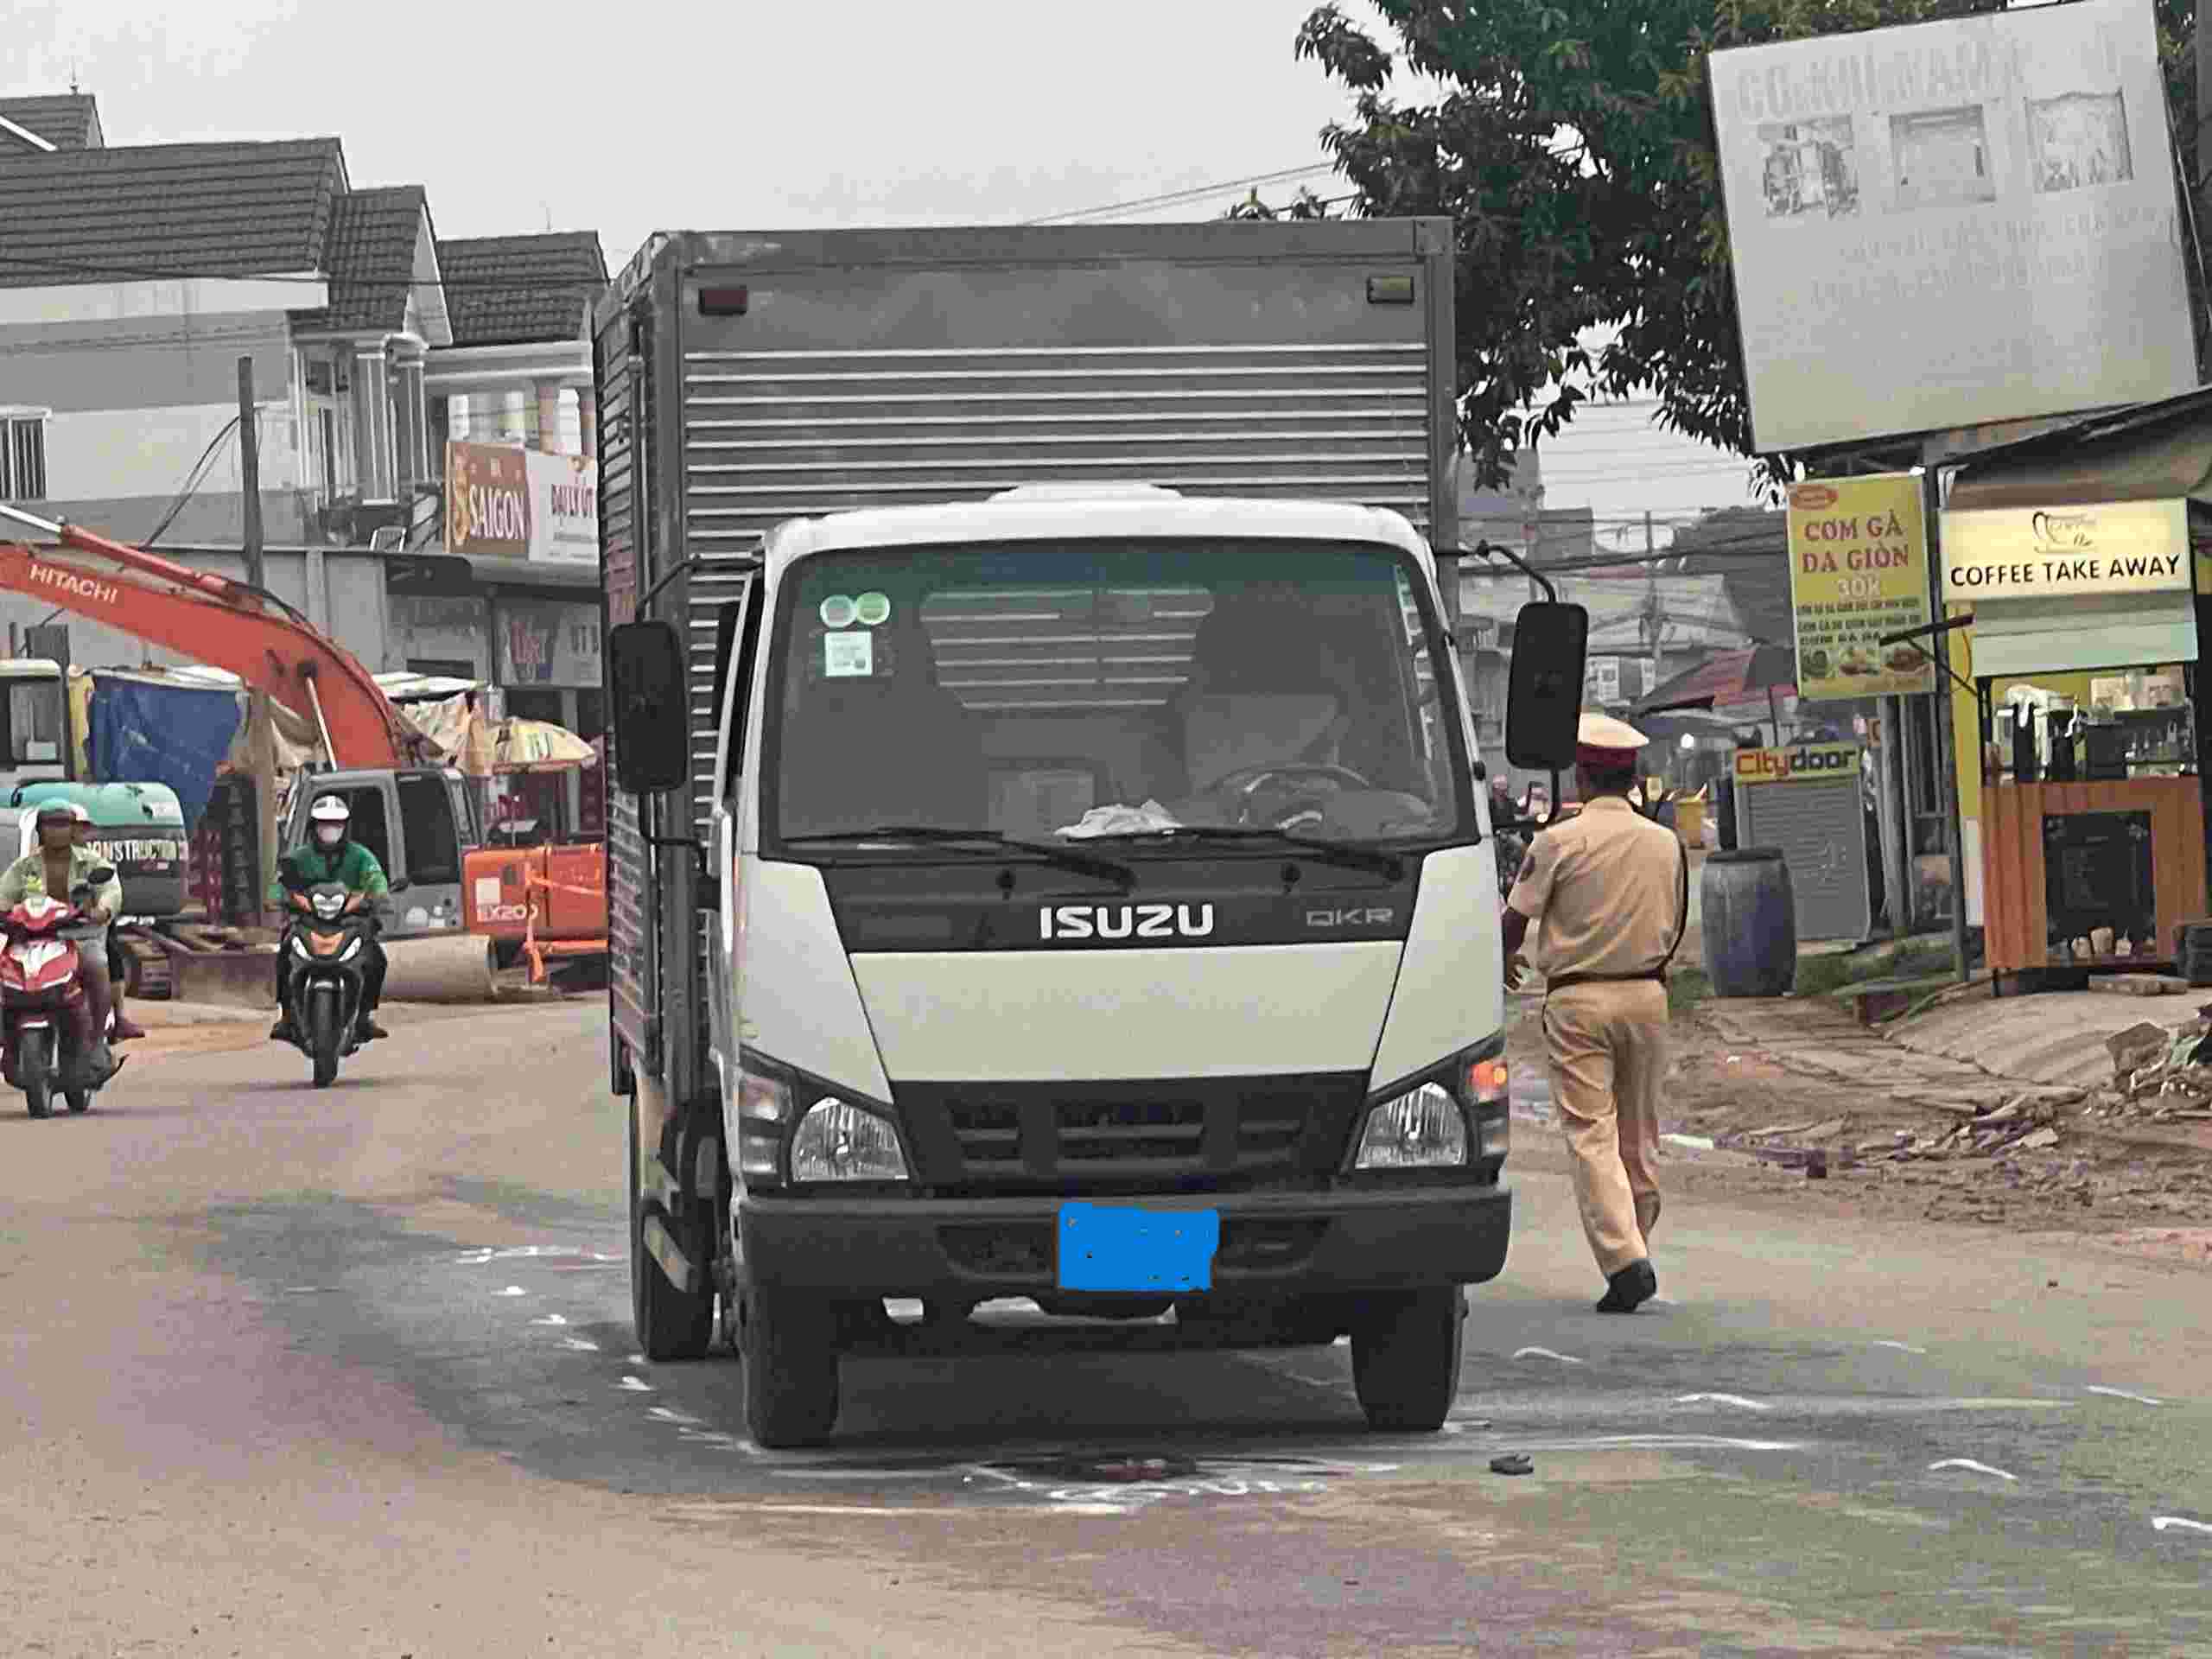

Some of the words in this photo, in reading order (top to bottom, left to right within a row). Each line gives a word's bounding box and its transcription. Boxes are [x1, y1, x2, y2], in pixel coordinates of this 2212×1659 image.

[469, 485, 525, 539] SAIGON
[1802, 551, 1838, 573] DA
[1950, 563, 2033, 586] COFFEE
[2044, 560, 2100, 582] TAKE
[2108, 554, 2179, 579] AWAY
[29, 564, 118, 603] HITACHI
[1039, 904, 1215, 939] ISUZU
